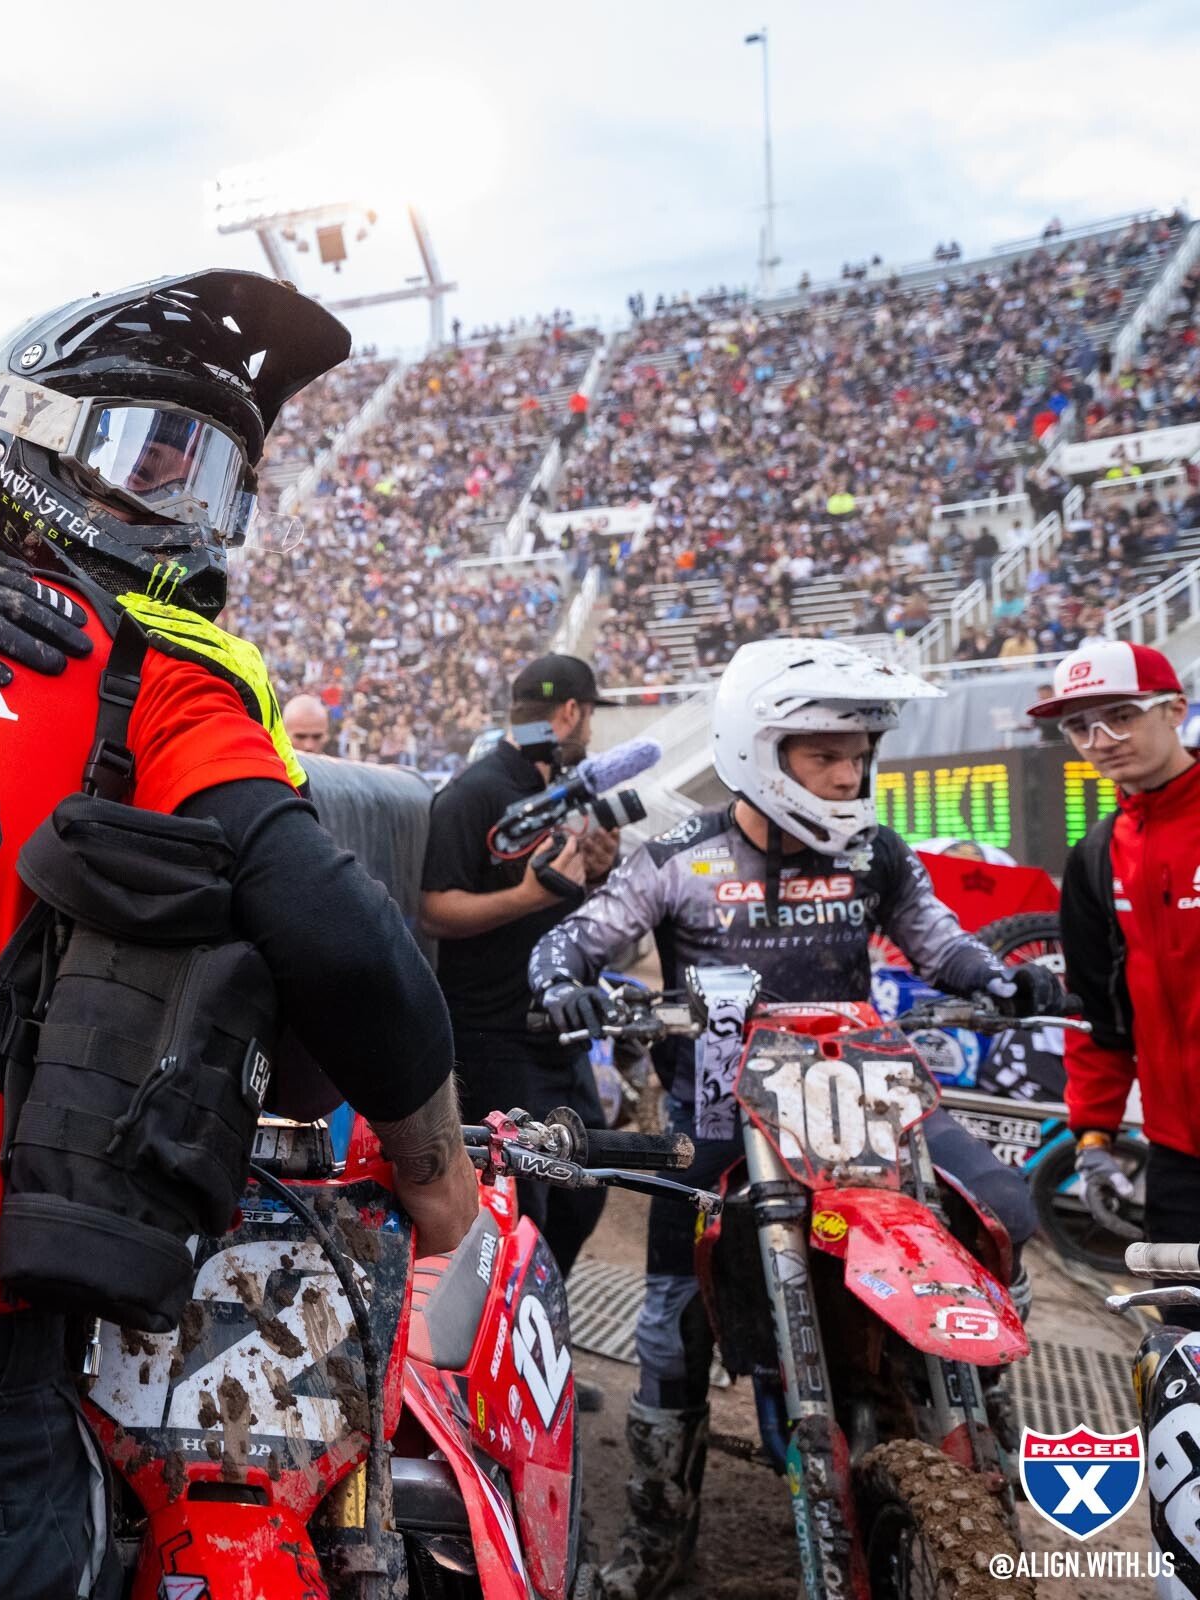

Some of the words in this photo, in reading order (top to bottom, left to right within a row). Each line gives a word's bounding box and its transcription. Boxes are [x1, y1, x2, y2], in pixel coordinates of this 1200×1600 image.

[1, 493, 73, 548] ENERGY
[718, 876, 851, 900] GAGAS
[762, 1060, 923, 1162] 105
[477, 1232, 497, 1285] HONDA
[512, 1294, 572, 1430] 12
